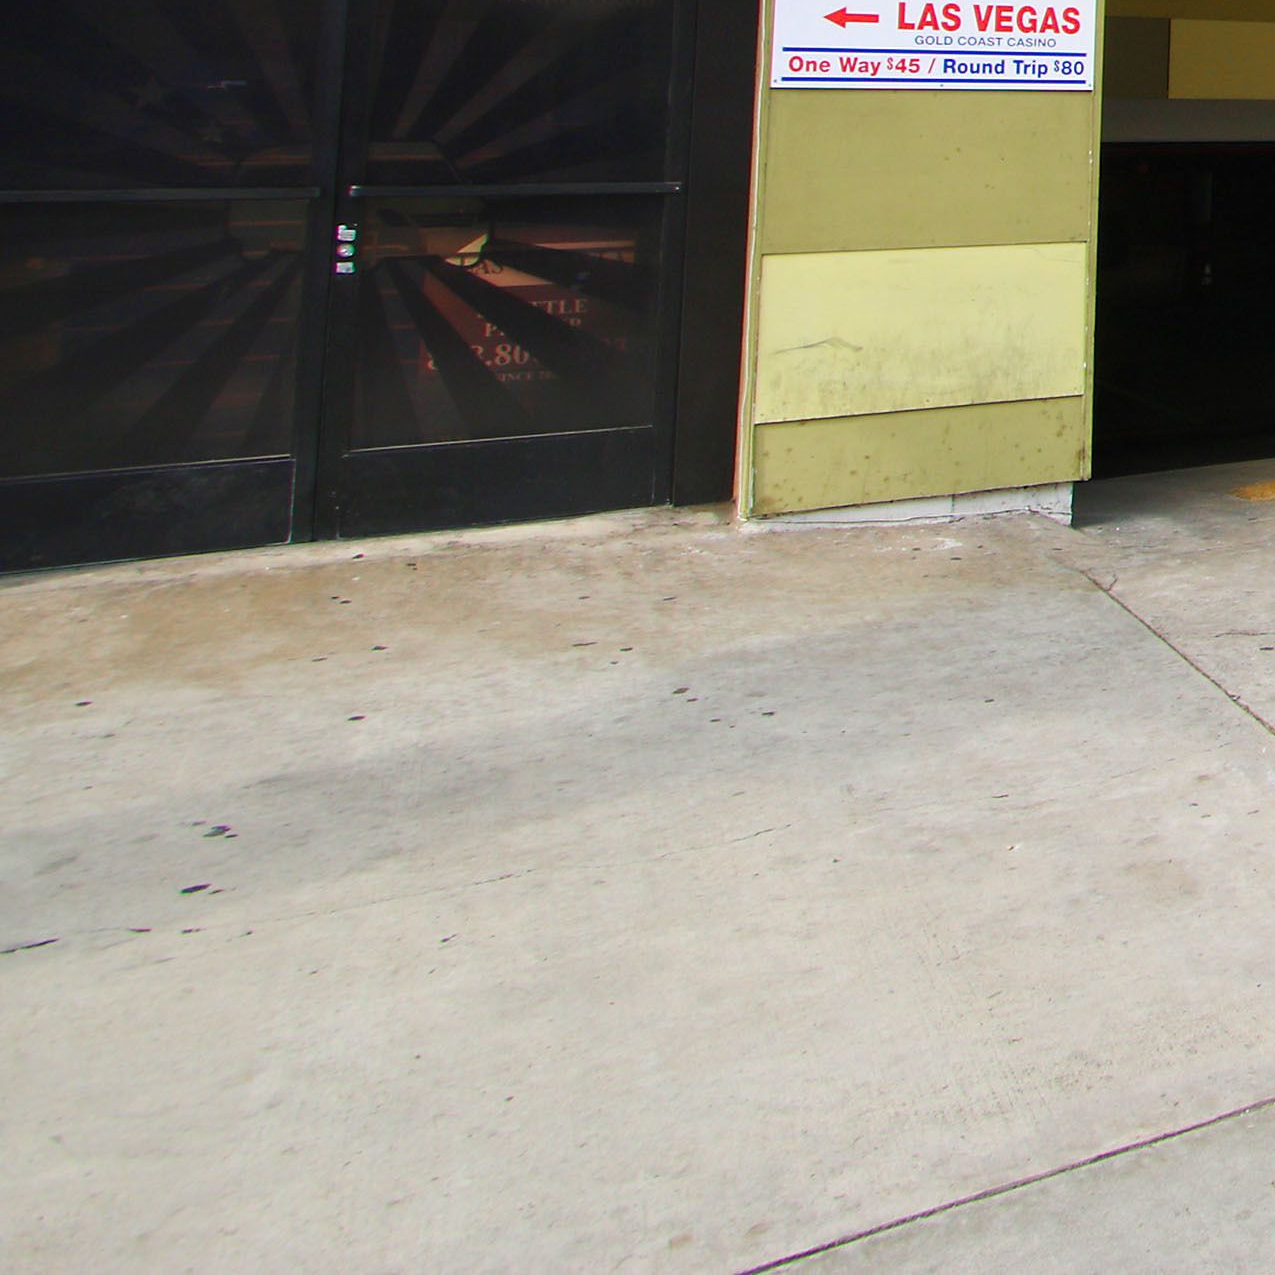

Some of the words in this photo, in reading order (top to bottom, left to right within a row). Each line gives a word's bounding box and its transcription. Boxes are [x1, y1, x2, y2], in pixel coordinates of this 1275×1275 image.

[897, 1, 961, 31] LAS
[973, 4, 1081, 35] VEGAS
[914, 35, 953, 46] GOLD
[957, 36, 1003, 47] COAST
[1007, 37, 1057, 48] CASINO
[788, 56, 831, 73] One
[839, 57, 881, 76] Way
[886, 57, 920, 73] $45
[927, 57, 936, 74] /
[943, 58, 1005, 75] Round
[1013, 59, 1049, 78] Trip
[1053, 60, 1085, 75] $80
